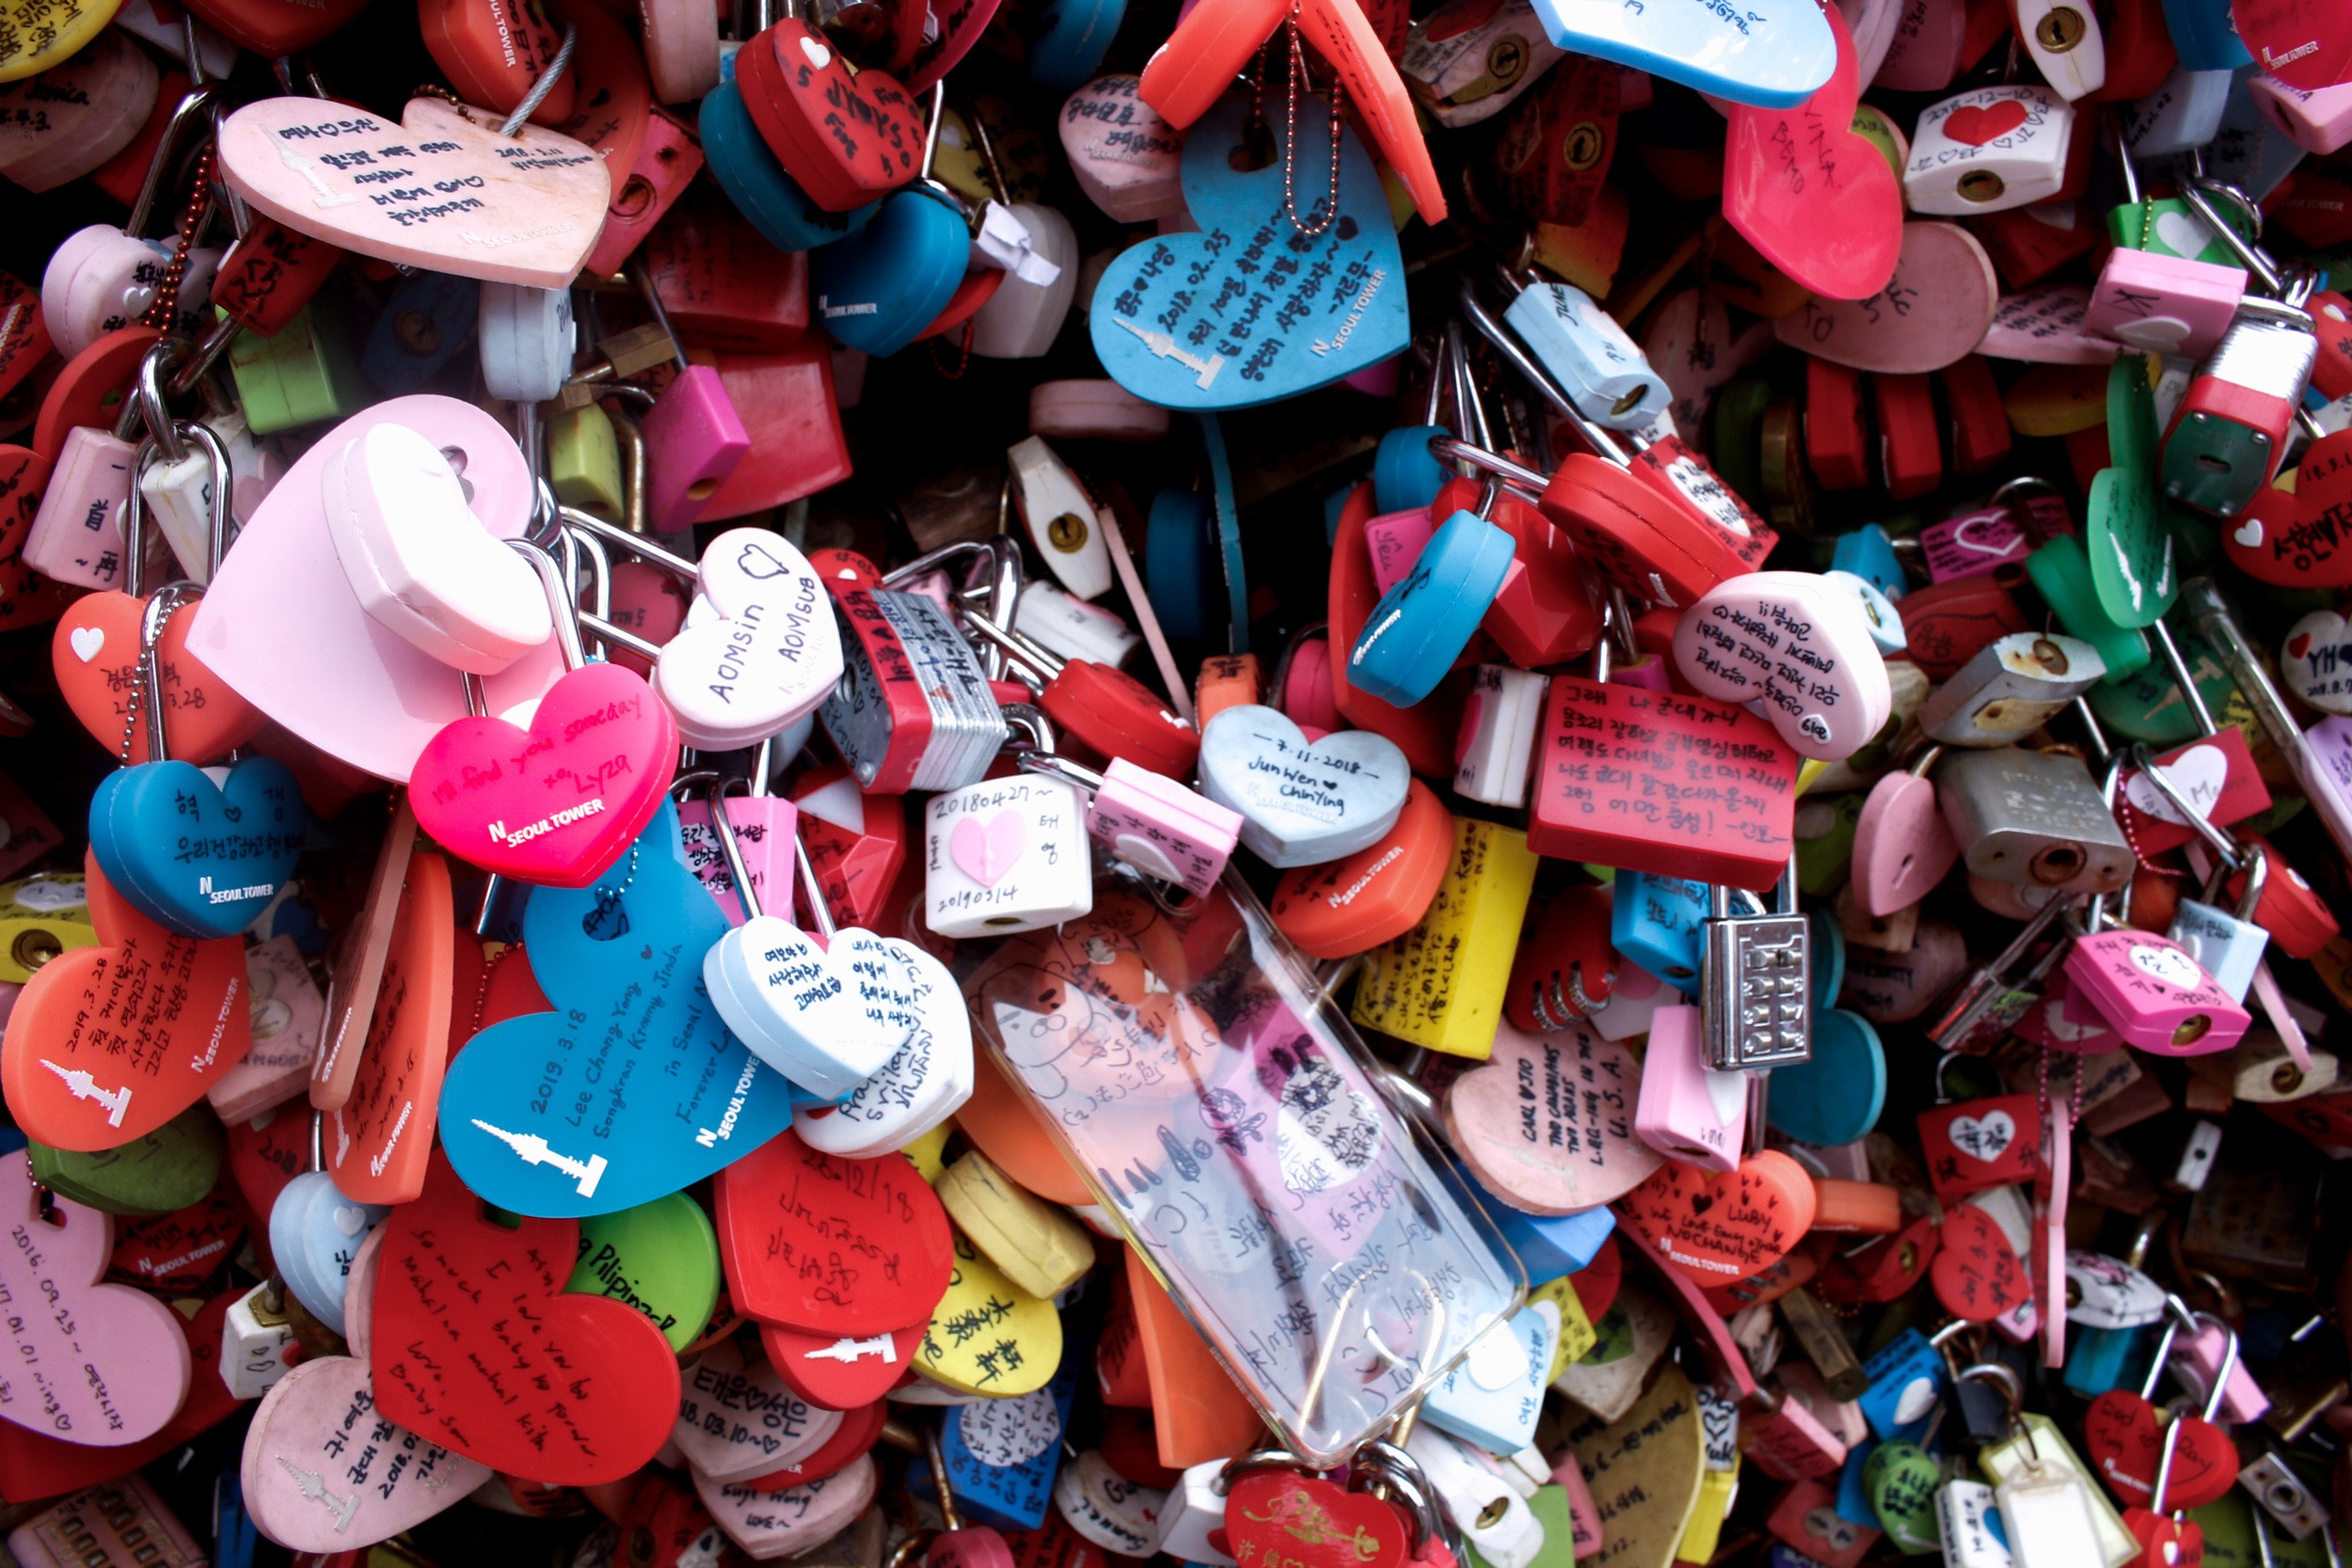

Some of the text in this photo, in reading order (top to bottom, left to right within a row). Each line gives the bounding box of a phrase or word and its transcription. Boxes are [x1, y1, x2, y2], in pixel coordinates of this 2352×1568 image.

[487, 819, 508, 843] N
[190, 1054, 209, 1073] N
[696, 1129, 717, 1148] N
